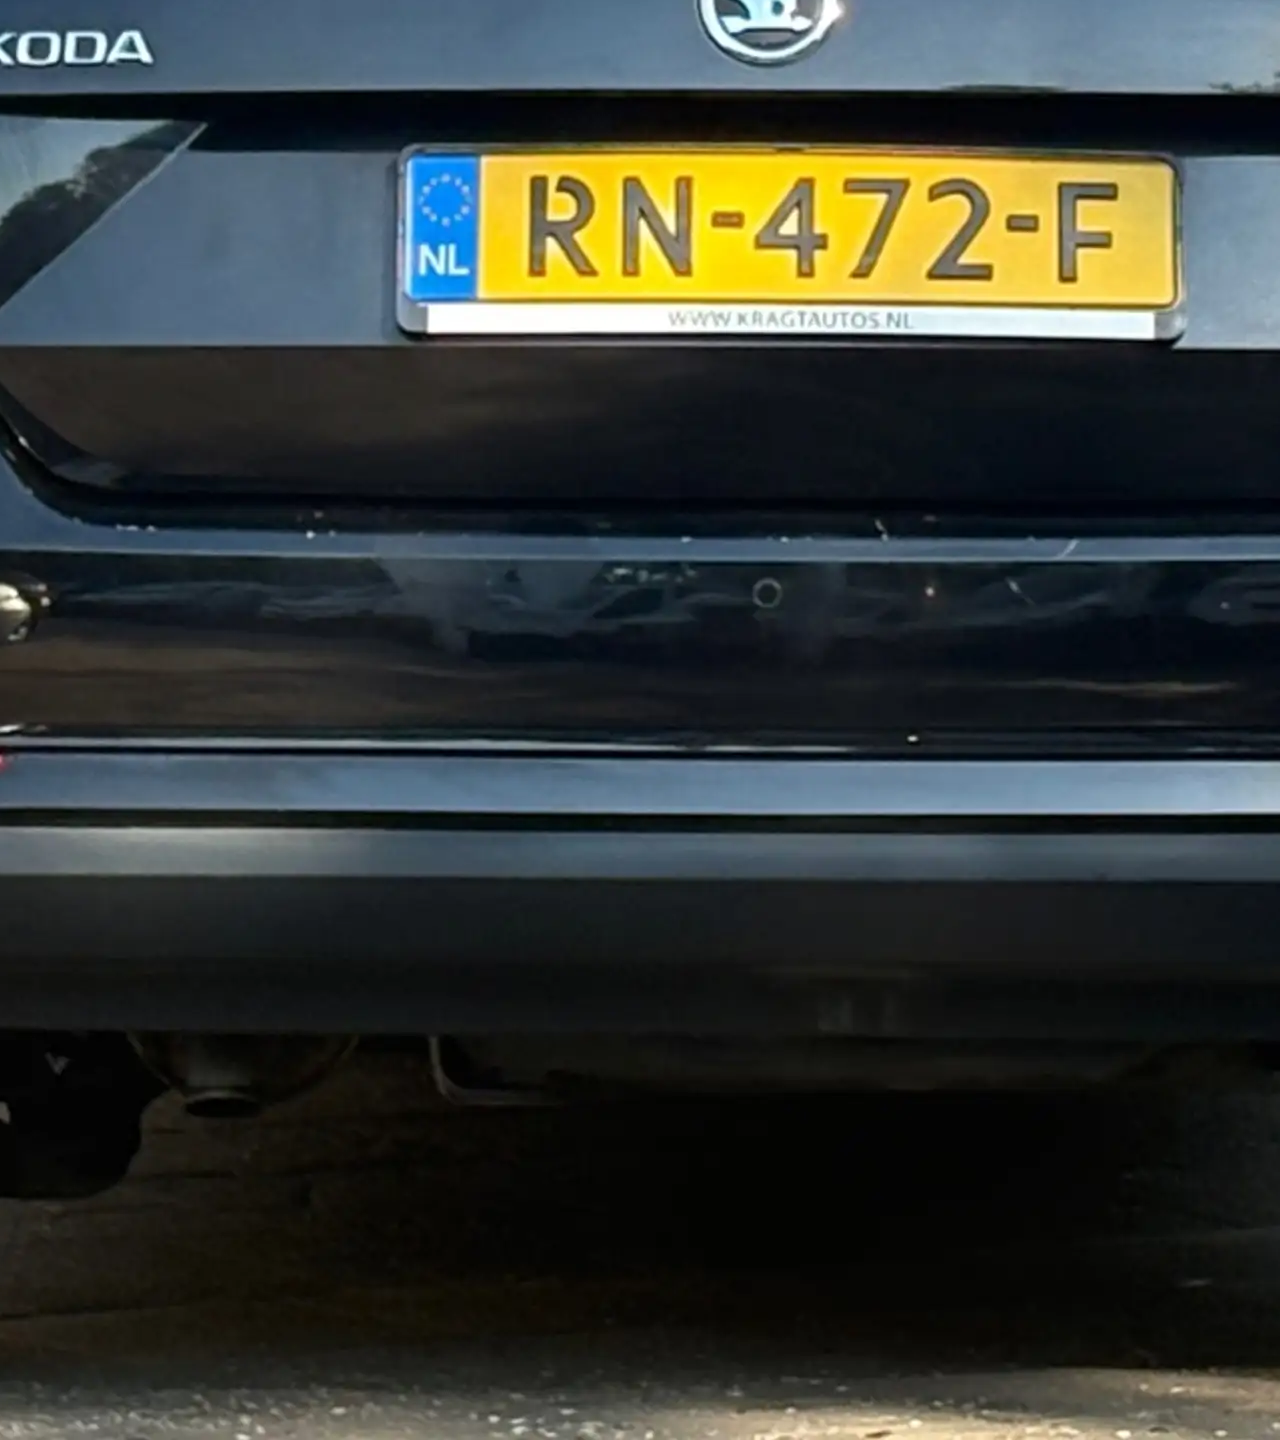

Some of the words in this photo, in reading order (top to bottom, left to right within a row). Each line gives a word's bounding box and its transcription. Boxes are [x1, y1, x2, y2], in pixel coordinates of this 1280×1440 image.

[527, 174, 1119, 283] RN-472-F
[418, 242, 471, 276] NL
[667, 309, 914, 330] WWW.KRAGTAUTOS.NL
